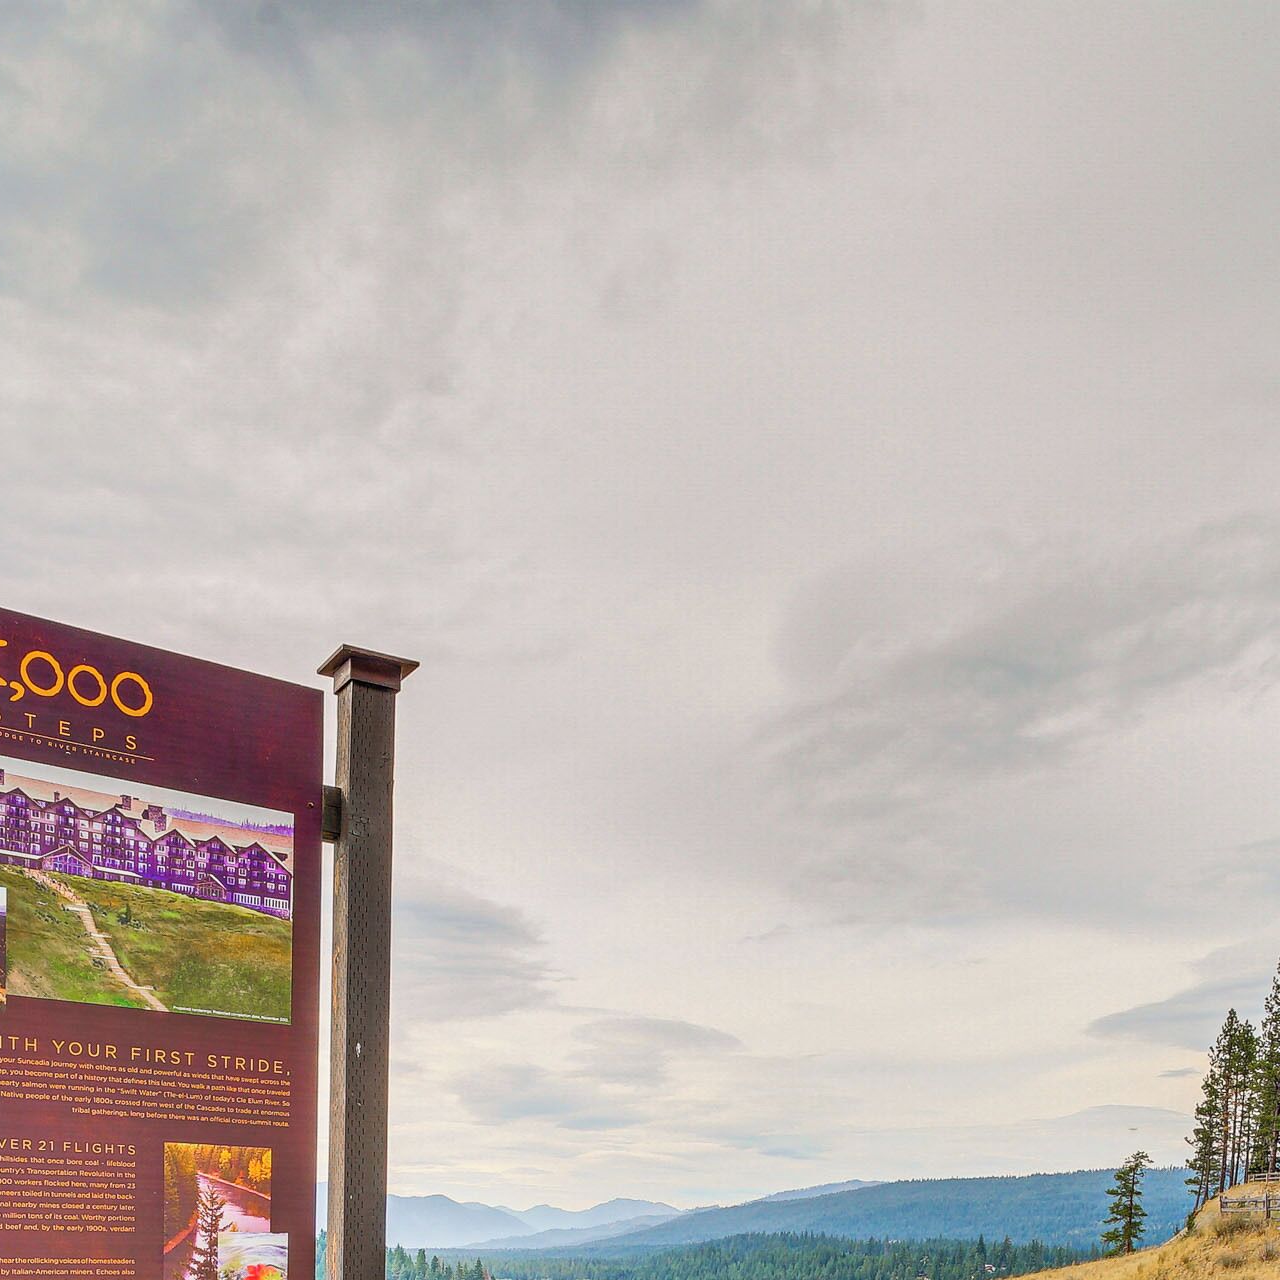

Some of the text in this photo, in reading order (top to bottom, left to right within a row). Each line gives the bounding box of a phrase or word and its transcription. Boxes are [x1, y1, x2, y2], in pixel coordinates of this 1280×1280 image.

[48, 741, 77, 752] RIVER
[83, 748, 136, 764] STAIRCASE
[52, 1040, 118, 1059] YOUR
[131, 1048, 194, 1065] FIRST
[207, 1055, 291, 1076] STRIDE,
[0, 1090, 23, 1098] Native
[38, 1141, 54, 1151] 21
[63, 1142, 136, 1155] FLIGHTS
